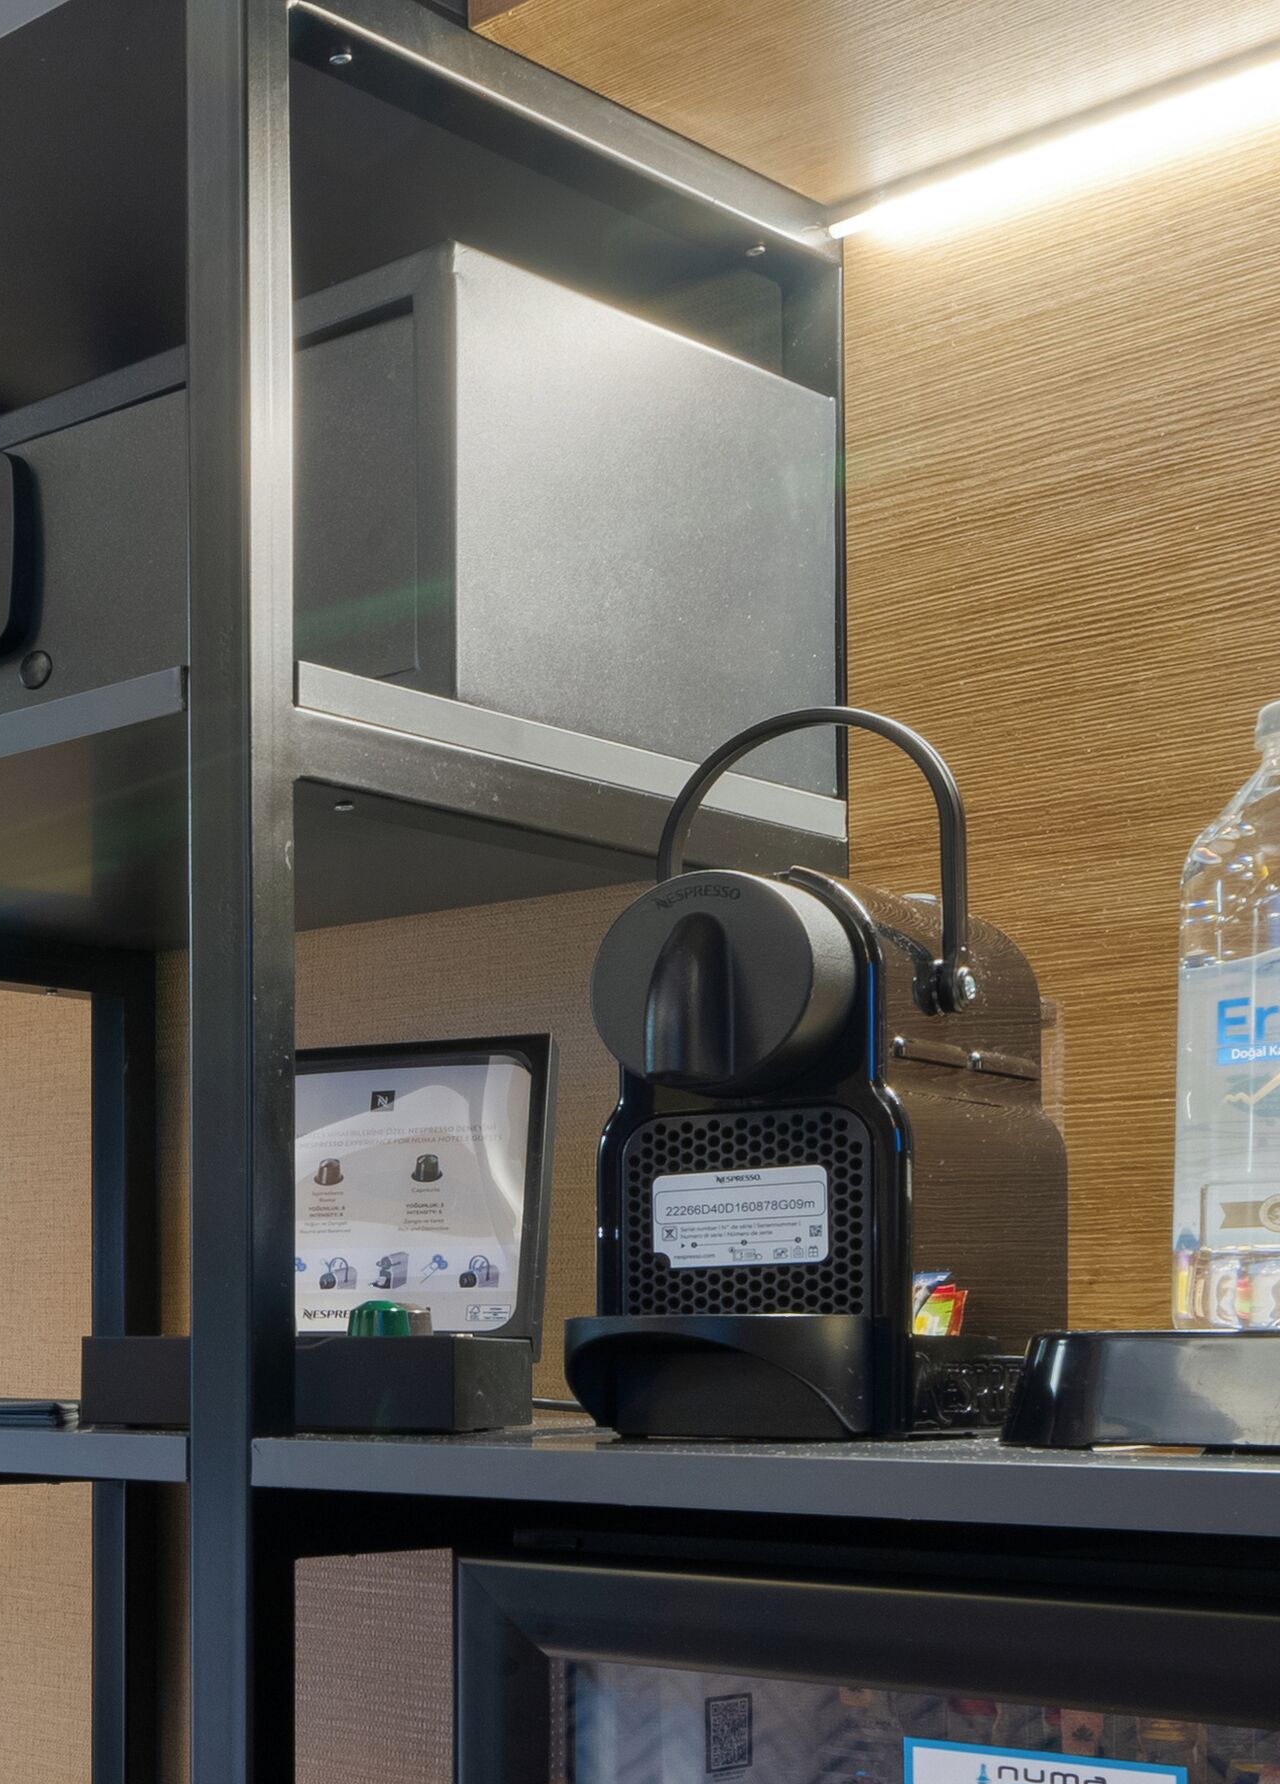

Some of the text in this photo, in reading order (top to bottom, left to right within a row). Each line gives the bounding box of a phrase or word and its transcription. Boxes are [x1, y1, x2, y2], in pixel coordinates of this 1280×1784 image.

[654, 884, 741, 910] NESPRESSO
[1231, 1047, 1267, 1061] Doğal
[715, 1173, 761, 1184] NESPRESSO
[665, 1198, 816, 1217] 22266D40D160878G09m
[302, 1307, 350, 1321] NESPRE
